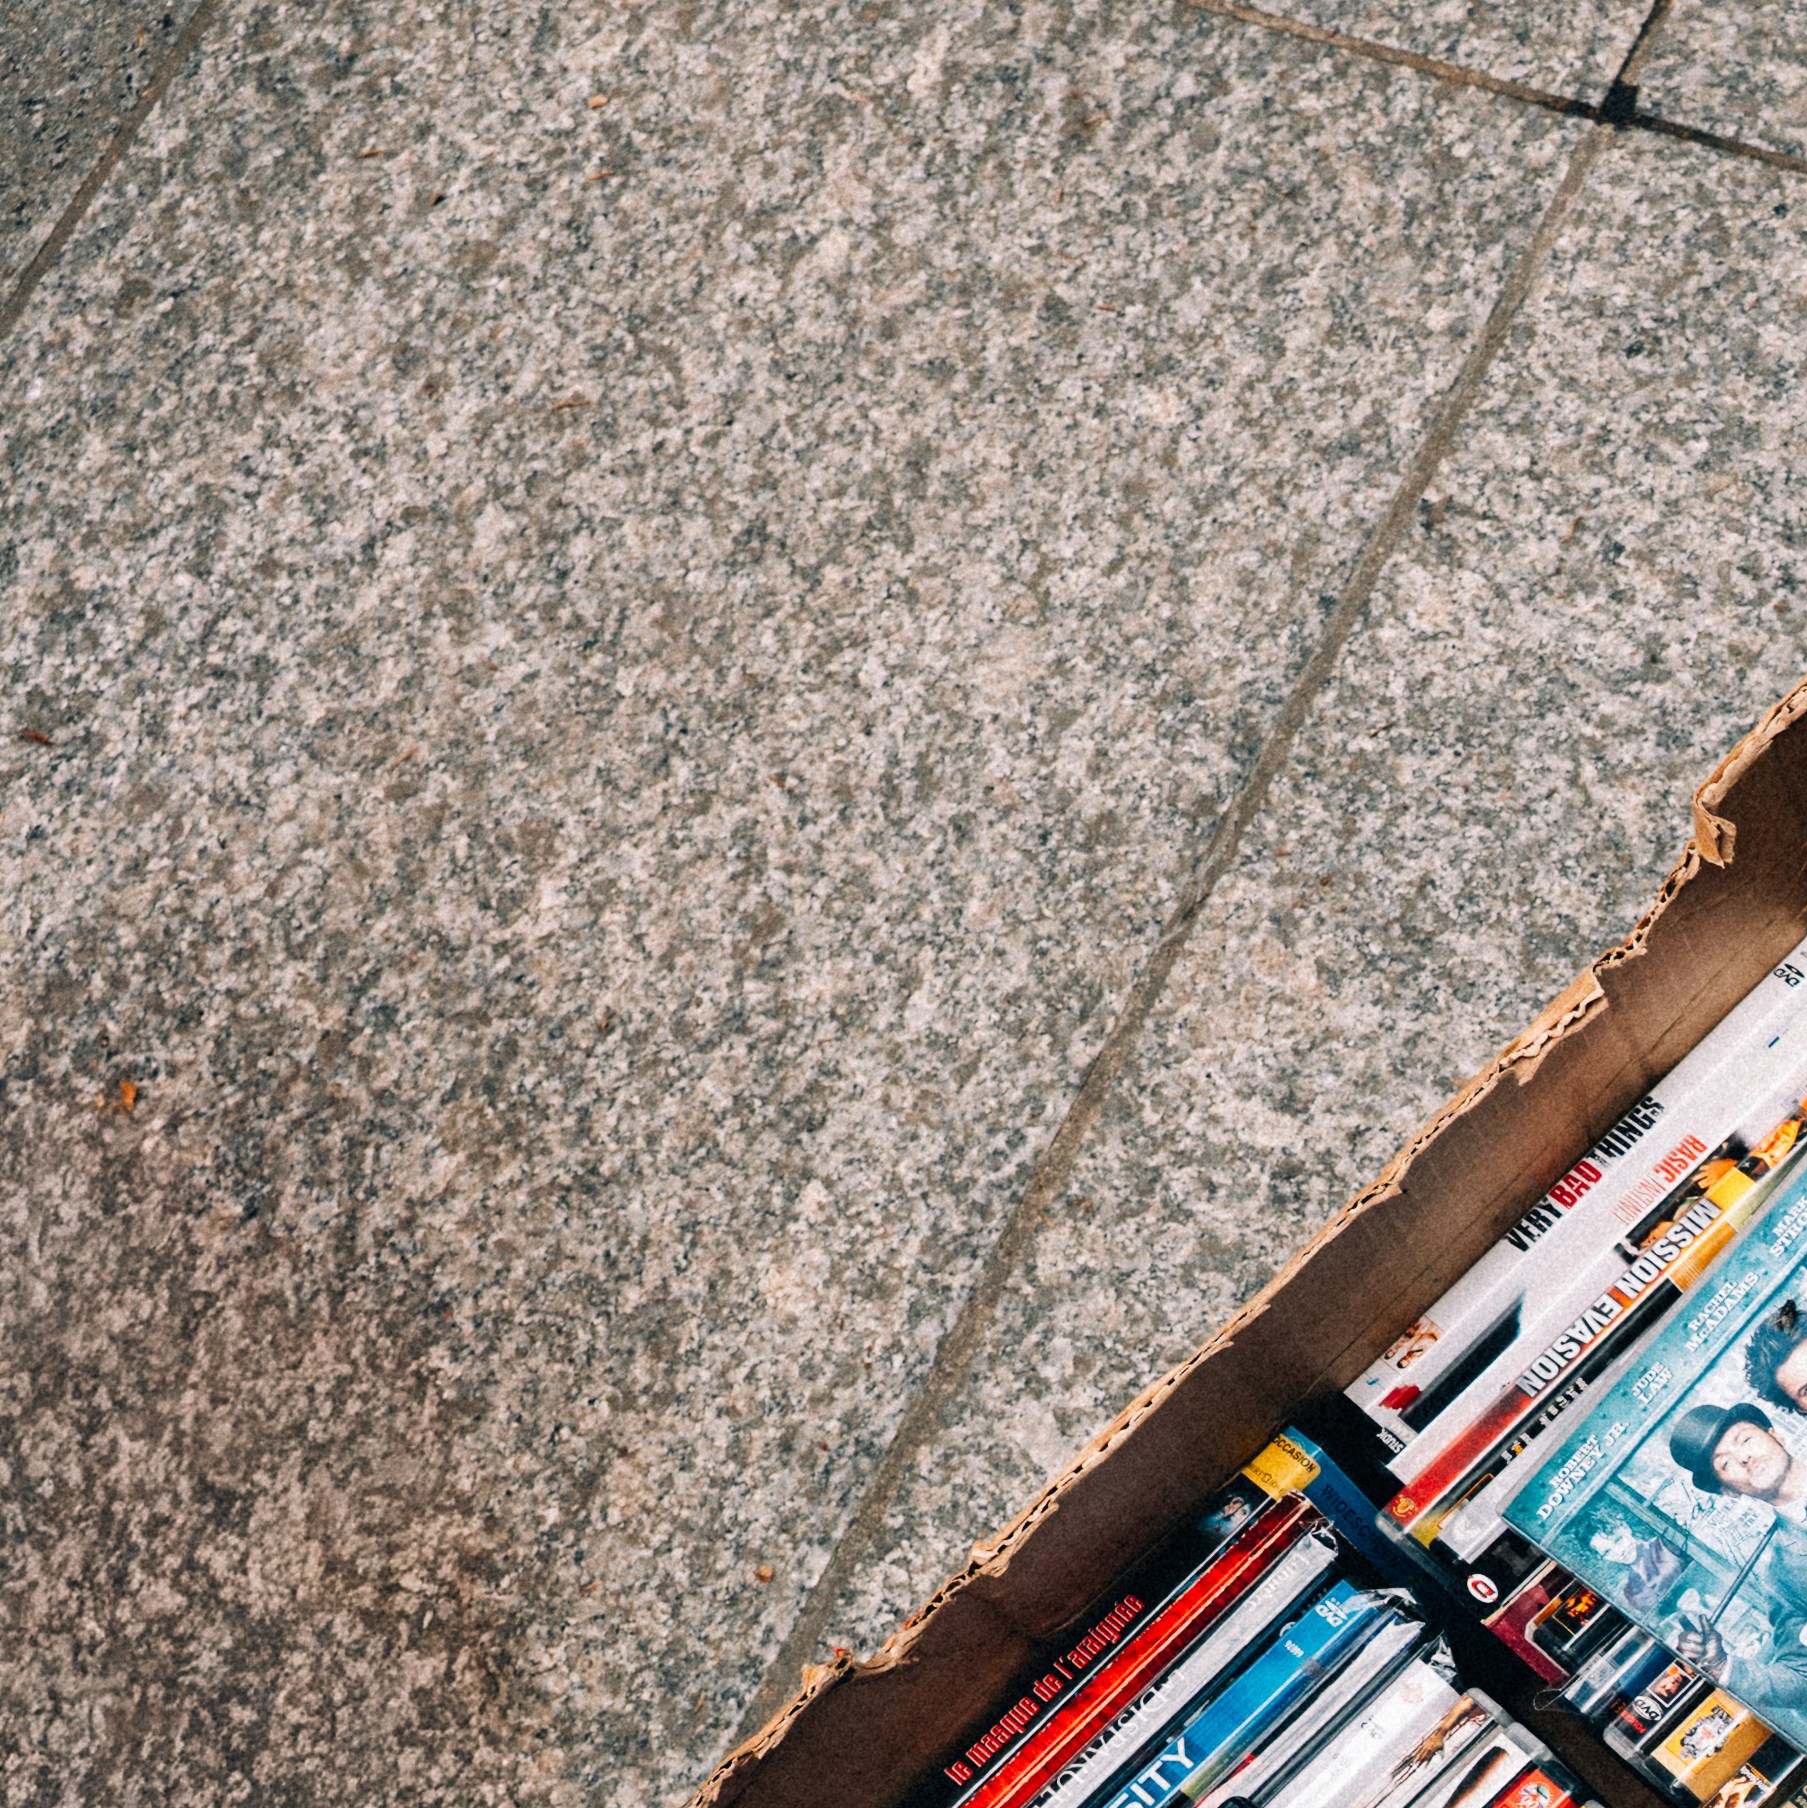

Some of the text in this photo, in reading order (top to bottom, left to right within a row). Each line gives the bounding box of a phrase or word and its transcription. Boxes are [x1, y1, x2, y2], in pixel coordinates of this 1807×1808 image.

[1514, 1193, 1724, 1399] MISSION EVASION
[1689, 1277, 1737, 1333] RACHEL
[1631, 1361, 1664, 1398] JUDE
[1639, 1366, 1674, 1405] LAW
[1551, 1433, 1599, 1488] ROBERT
[942, 1587, 1150, 1787] le masque de l'araignée
